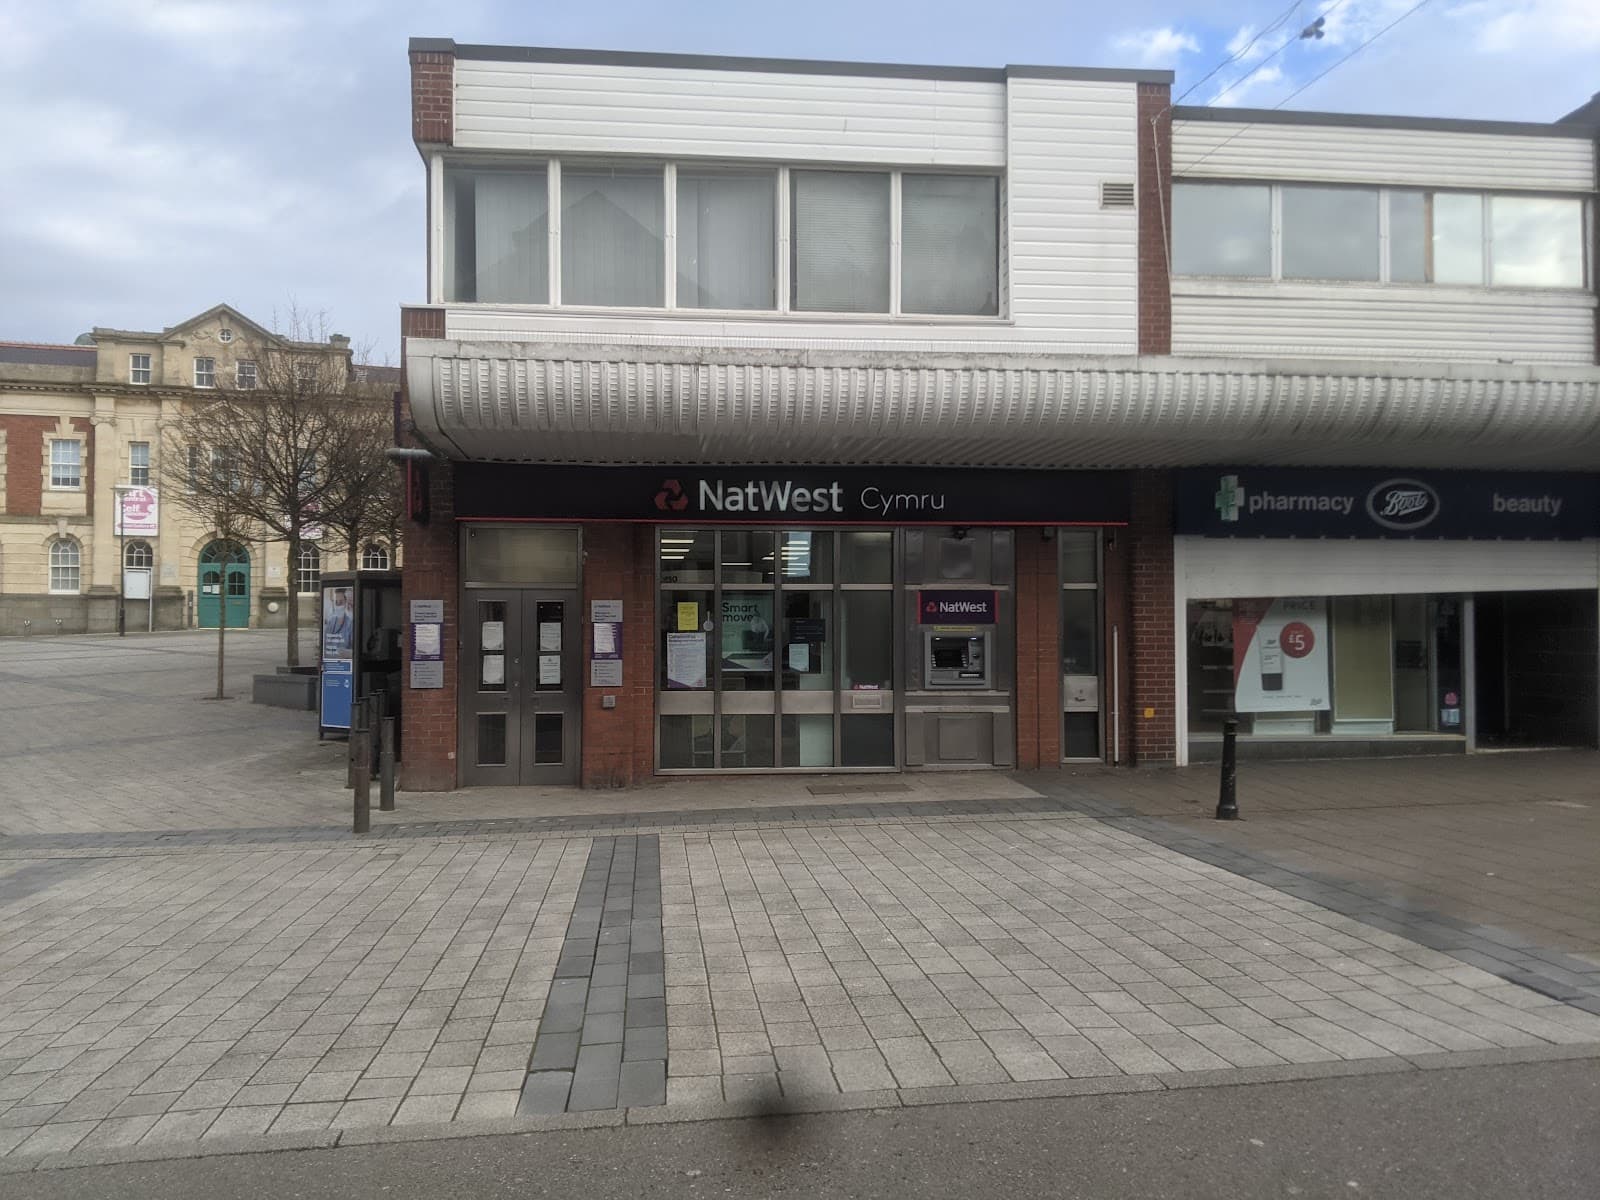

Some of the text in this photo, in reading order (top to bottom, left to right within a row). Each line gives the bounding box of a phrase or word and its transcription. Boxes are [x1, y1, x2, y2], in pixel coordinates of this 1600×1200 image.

[698, 479, 945, 516] NatWest Cymru
[1249, 492, 1355, 515] pharmacy
[1380, 490, 1429, 517] Boots
[1492, 493, 1563, 517] beauty
[722, 602, 759, 613] Smart
[939, 601, 988, 613] NatWest
[1288, 634, 1306, 651] £5
